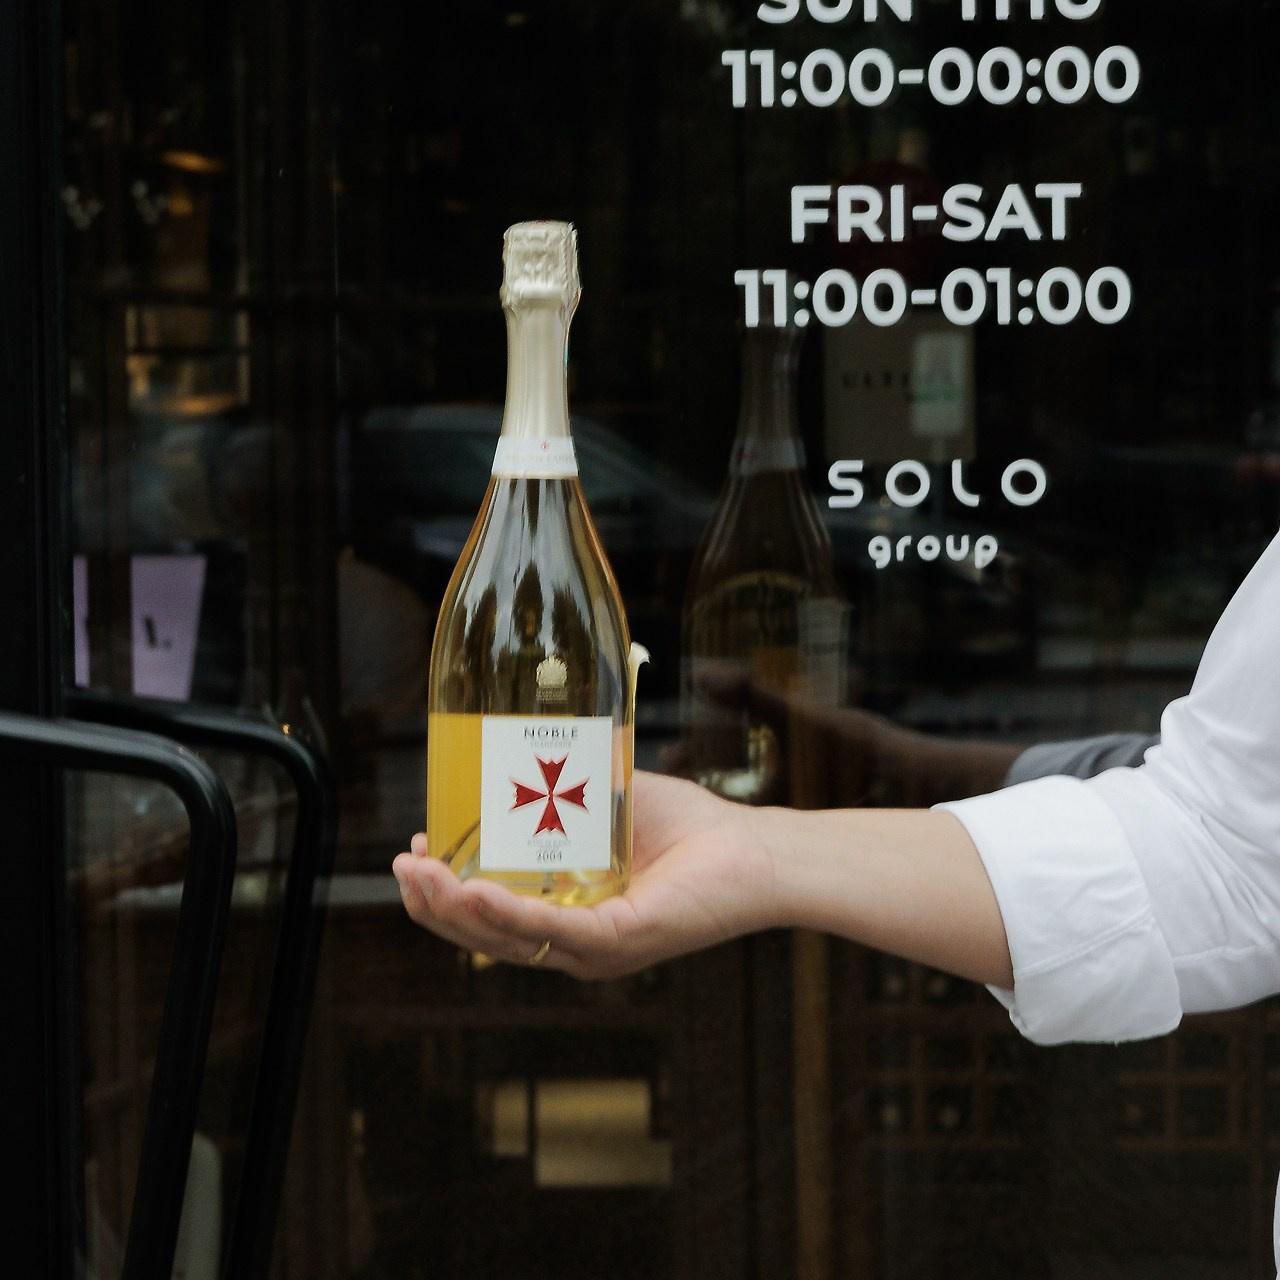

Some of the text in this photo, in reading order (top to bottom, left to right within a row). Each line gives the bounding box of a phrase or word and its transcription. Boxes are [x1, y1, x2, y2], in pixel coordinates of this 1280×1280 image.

[721, 45, 1140, 107] 11:00-00:00
[790, 182, 1083, 242] FRI-SAT
[733, 266, 1132, 327] 11:00-01:00
[827, 458, 1047, 508] SOLO
[867, 534, 999, 569] group
[523, 725, 578, 740] NOBLE
